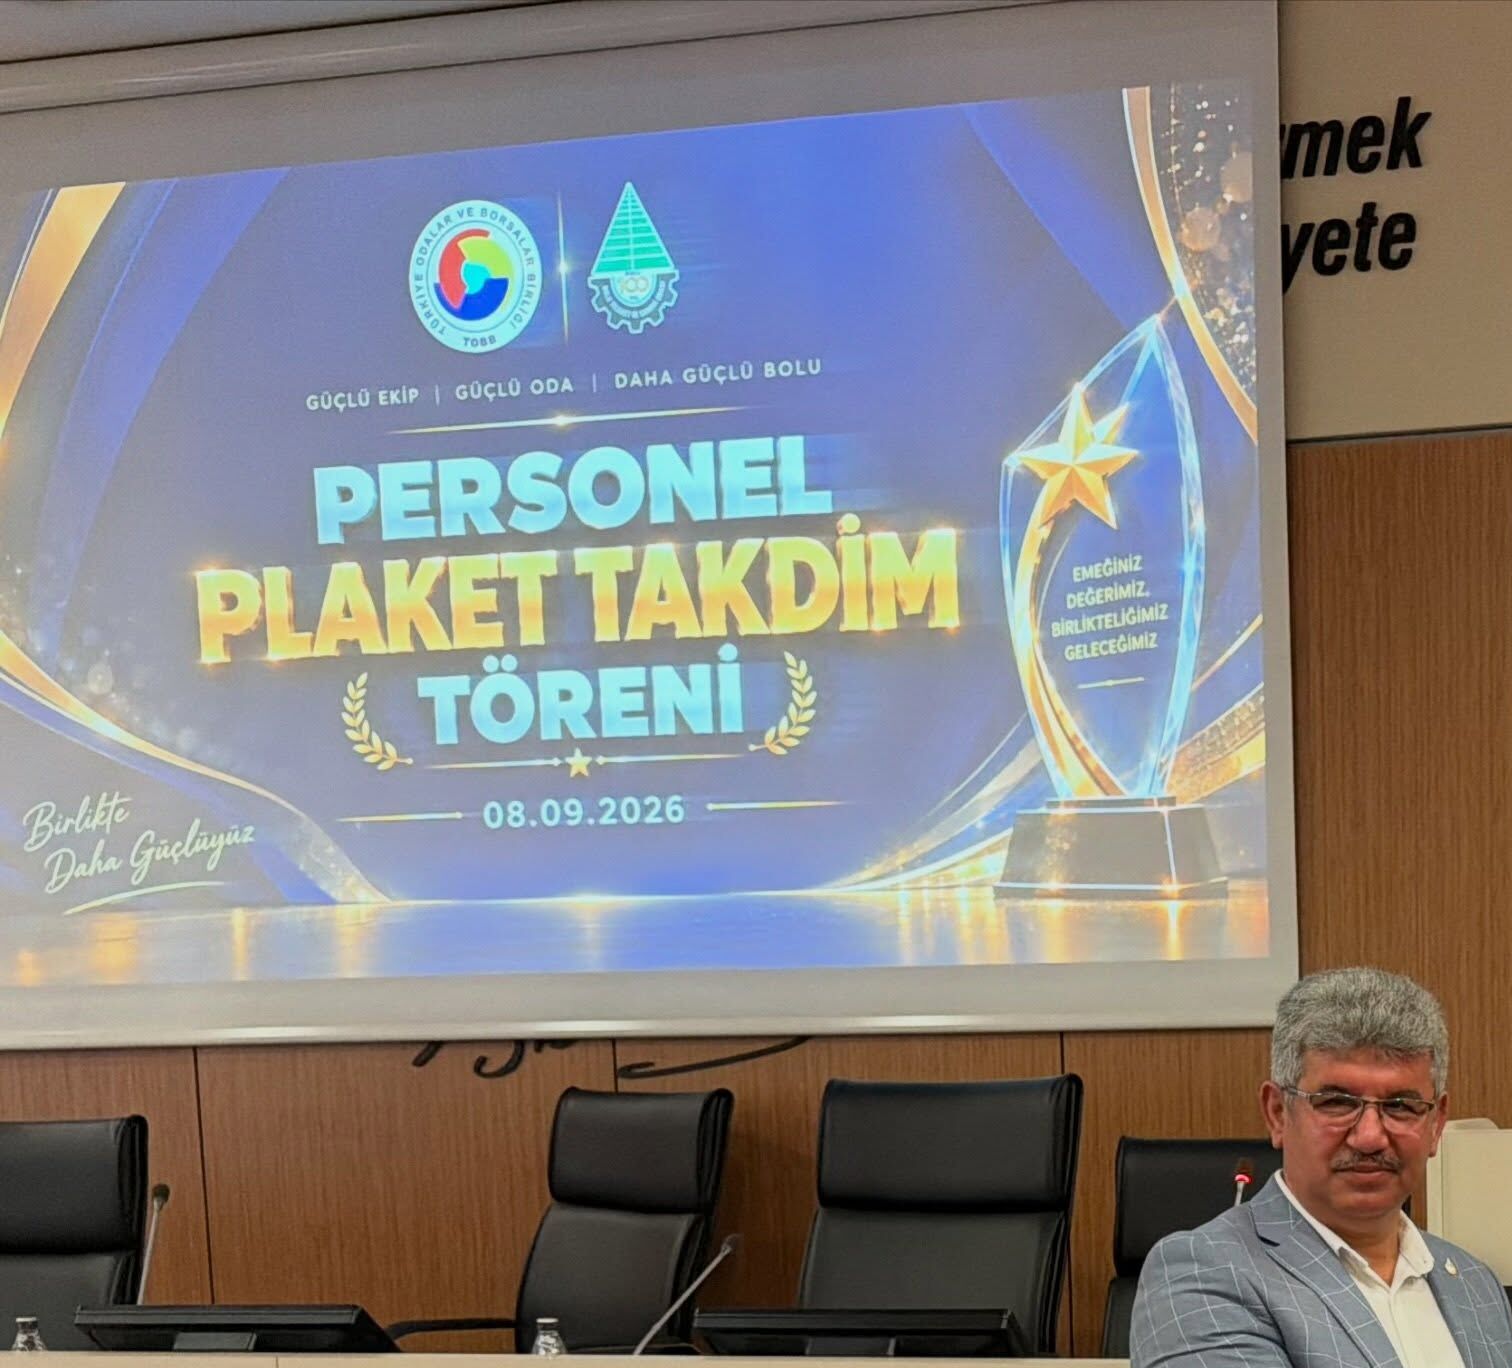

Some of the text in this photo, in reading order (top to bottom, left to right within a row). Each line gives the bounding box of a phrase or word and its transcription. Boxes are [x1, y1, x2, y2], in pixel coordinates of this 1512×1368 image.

[1280, 96, 1432, 179] mek
[416, 214, 453, 266] ODALAR
[457, 207, 474, 219] VE
[480, 208, 534, 265] BORSALAR
[463, 335, 497, 347] TOBB
[305, 358, 822, 413] GÜÇLÜ EKİP GÜÇLÜ ODA DAHA GÜÇLÜ BOLU
[313, 435, 832, 544] PERSONEL
[197, 513, 960, 664] PLAKET TAKDİM
[1072, 554, 1143, 583] EMEĞİNİZ
[1051, 603, 1169, 638] BİRLİKTELİĞİMİZ
[1064, 632, 1158, 661] GELECEĞİMİZ
[417, 642, 744, 746] TÖRENİ
[23, 792, 133, 852] Birlikte
[482, 794, 686, 831] 08.09.2026
[44, 818, 255, 893] Daha Güçlüyüz
